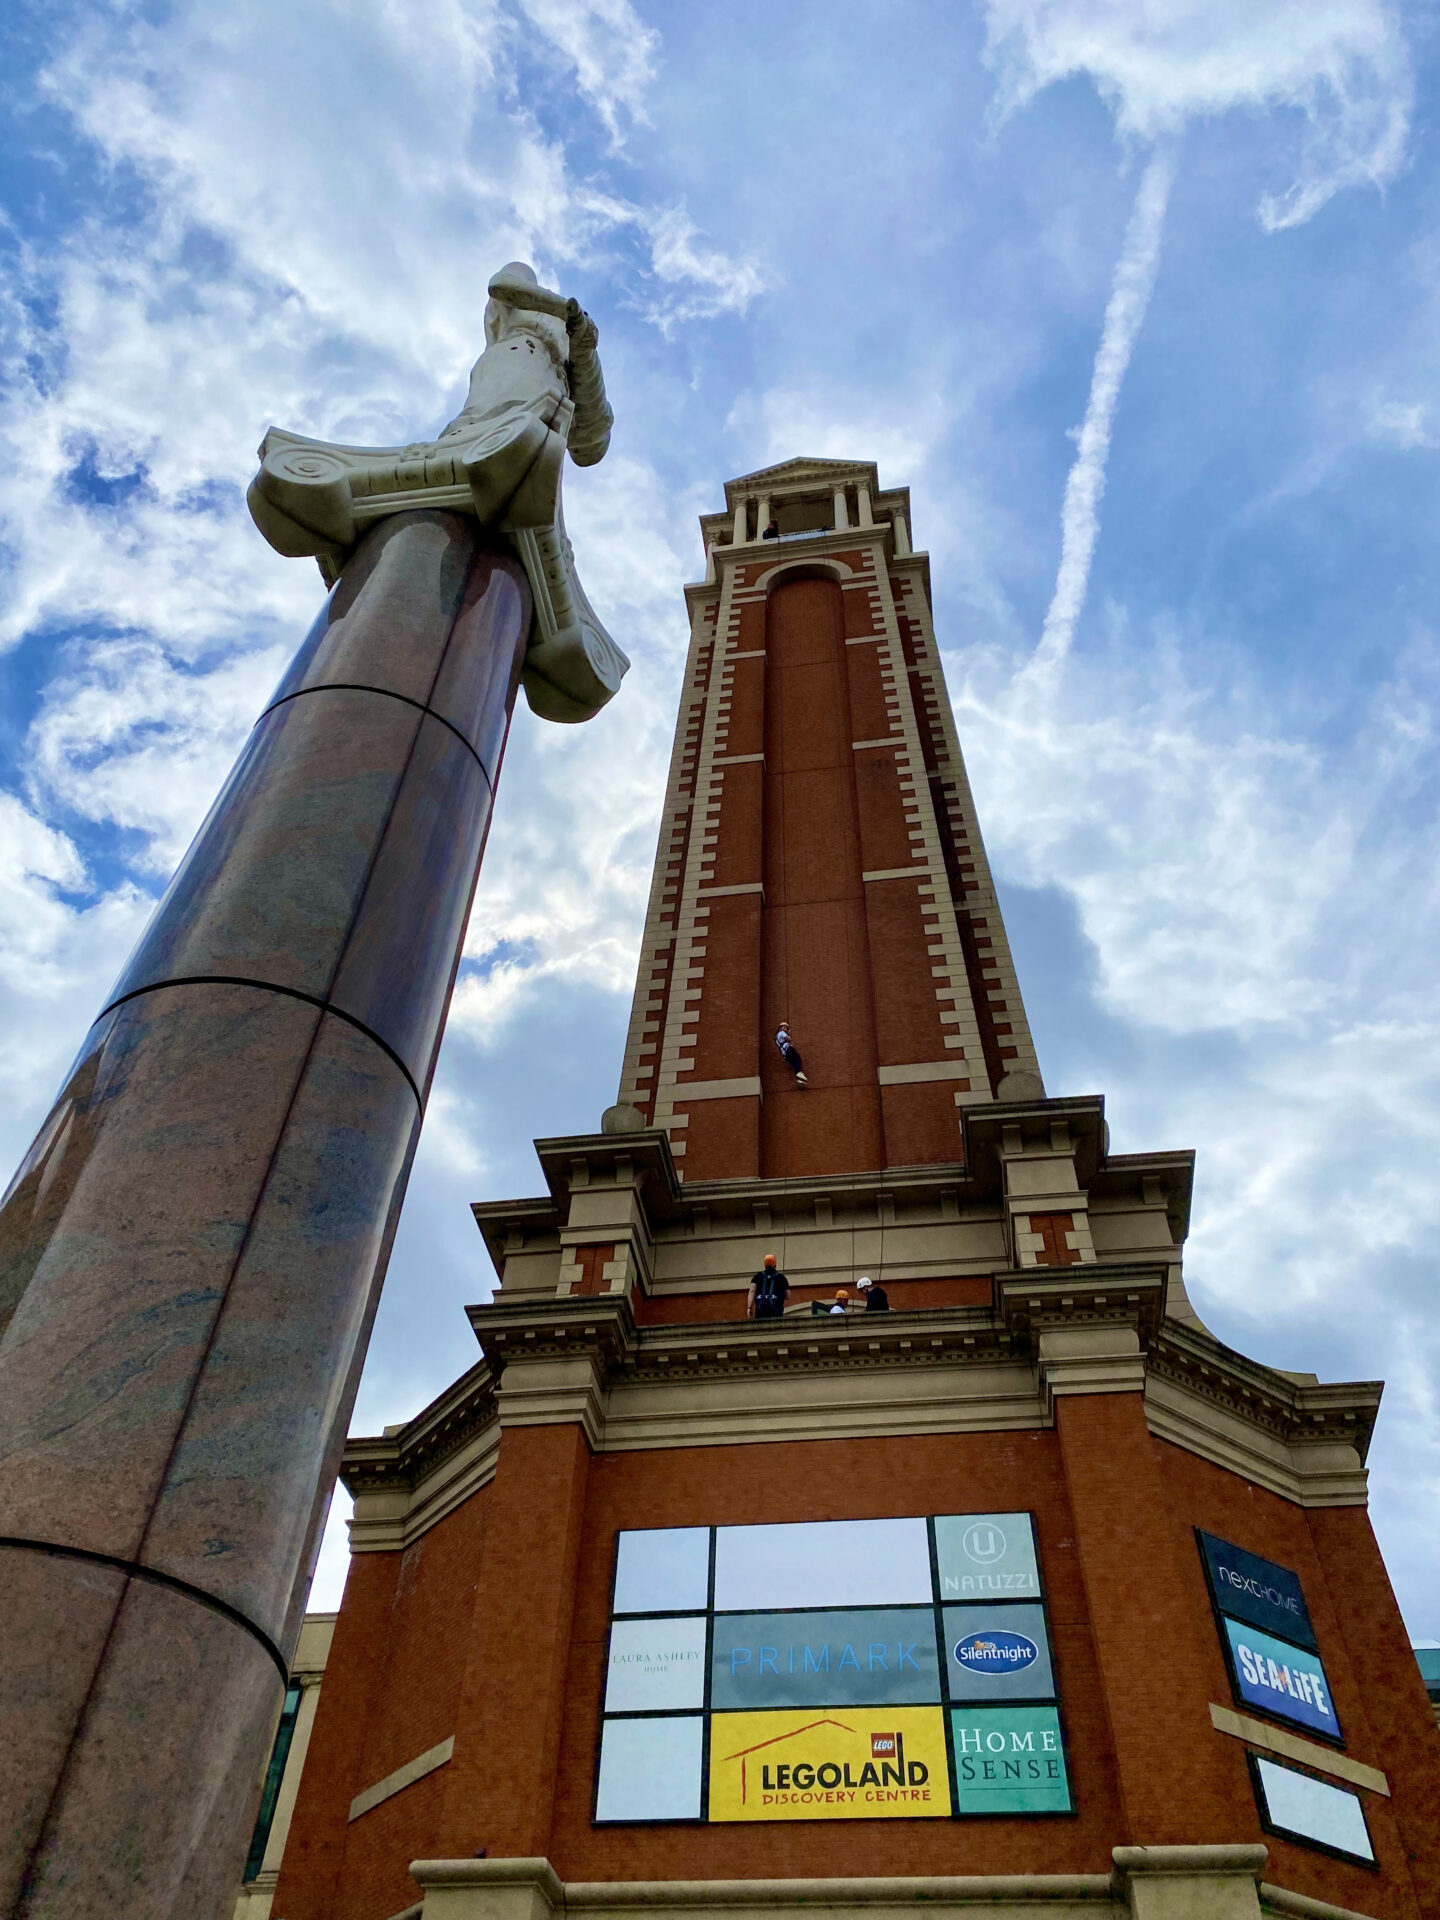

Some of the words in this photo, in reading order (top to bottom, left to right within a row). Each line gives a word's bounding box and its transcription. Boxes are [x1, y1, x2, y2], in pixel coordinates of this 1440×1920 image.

[945, 1573, 1034, 1592] NATUZZI
[612, 1652, 651, 1664] LAURA
[656, 1650, 701, 1662] ASHLEY
[730, 1642, 922, 1676] PRIMARK
[960, 1646, 1032, 1661] Silentnight
[643, 1665, 670, 1673] HOME
[1237, 1644, 1285, 1693] SEA
[873, 1740, 893, 1751] LEGO
[762, 1732, 930, 1790] LEGOLAND
[762, 1791, 856, 1805] DISCOVERY
[865, 1789, 931, 1802] CENTRE
